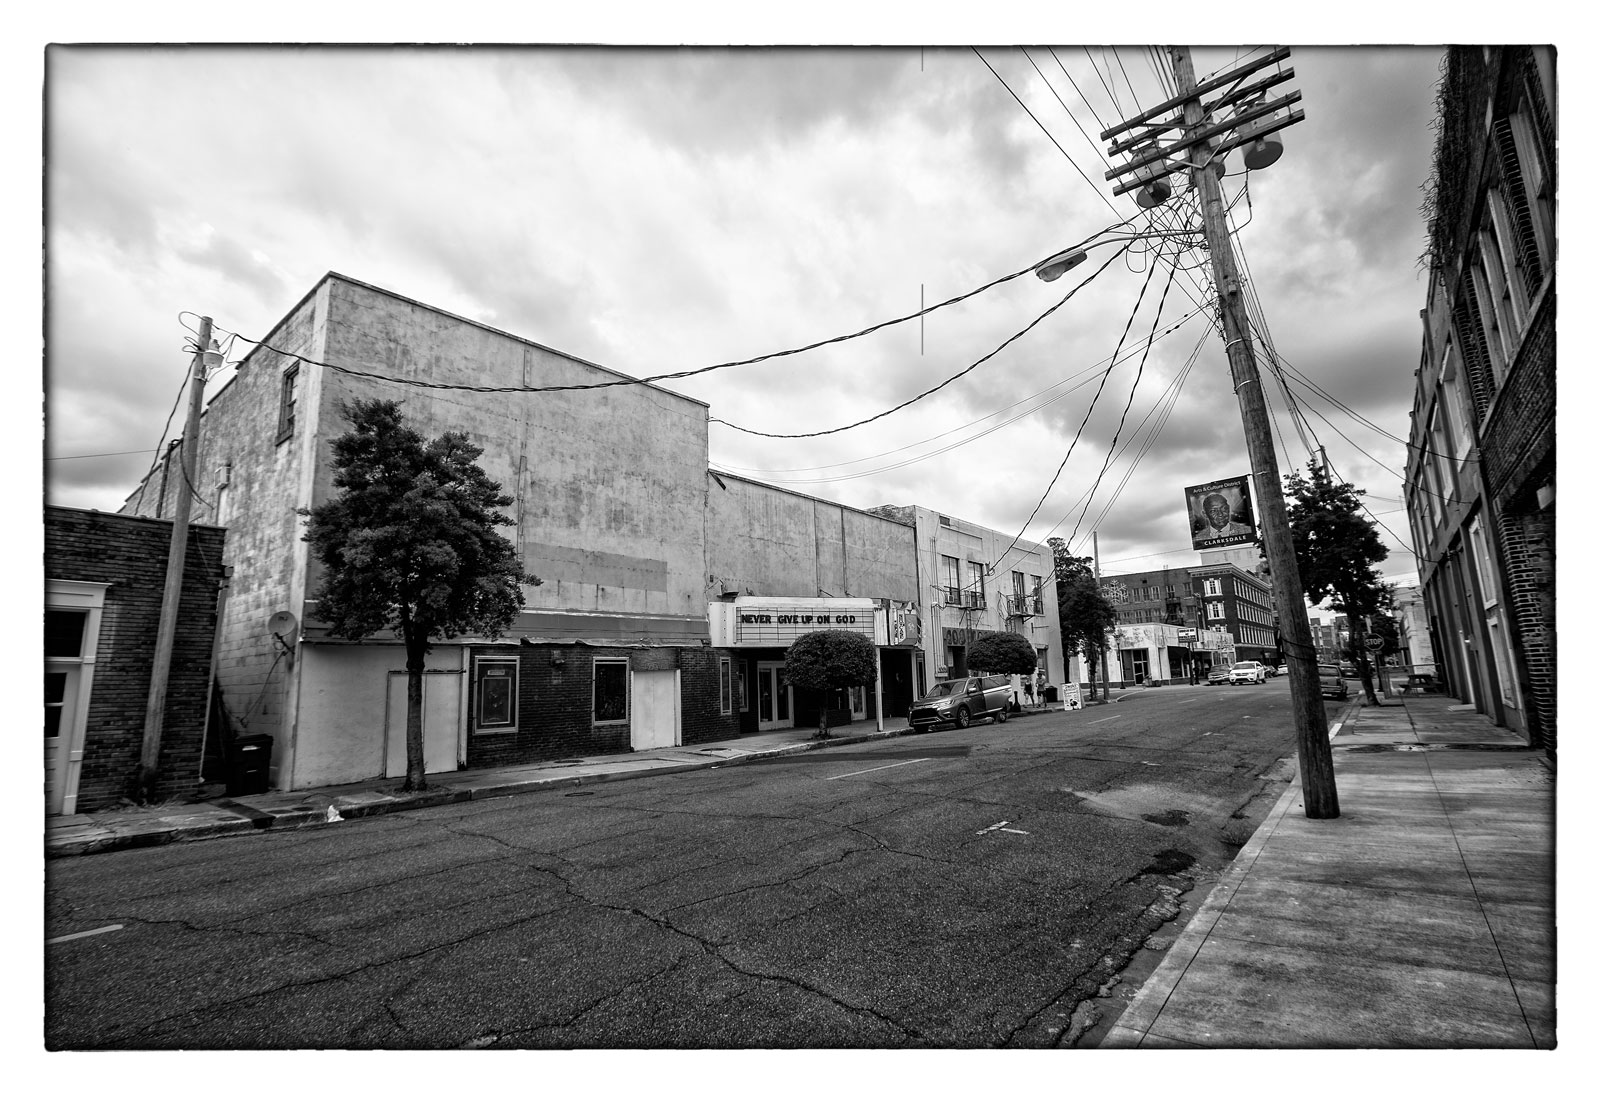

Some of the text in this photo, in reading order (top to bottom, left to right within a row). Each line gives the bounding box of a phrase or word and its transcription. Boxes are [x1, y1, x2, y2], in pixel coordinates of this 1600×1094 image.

[1224, 480, 1241, 488] District
[1204, 535, 1247, 546] CLARKSDALE
[741, 614, 856, 624] NEVER GIVE UP ON GOD
[1365, 638, 1382, 646] STOP
